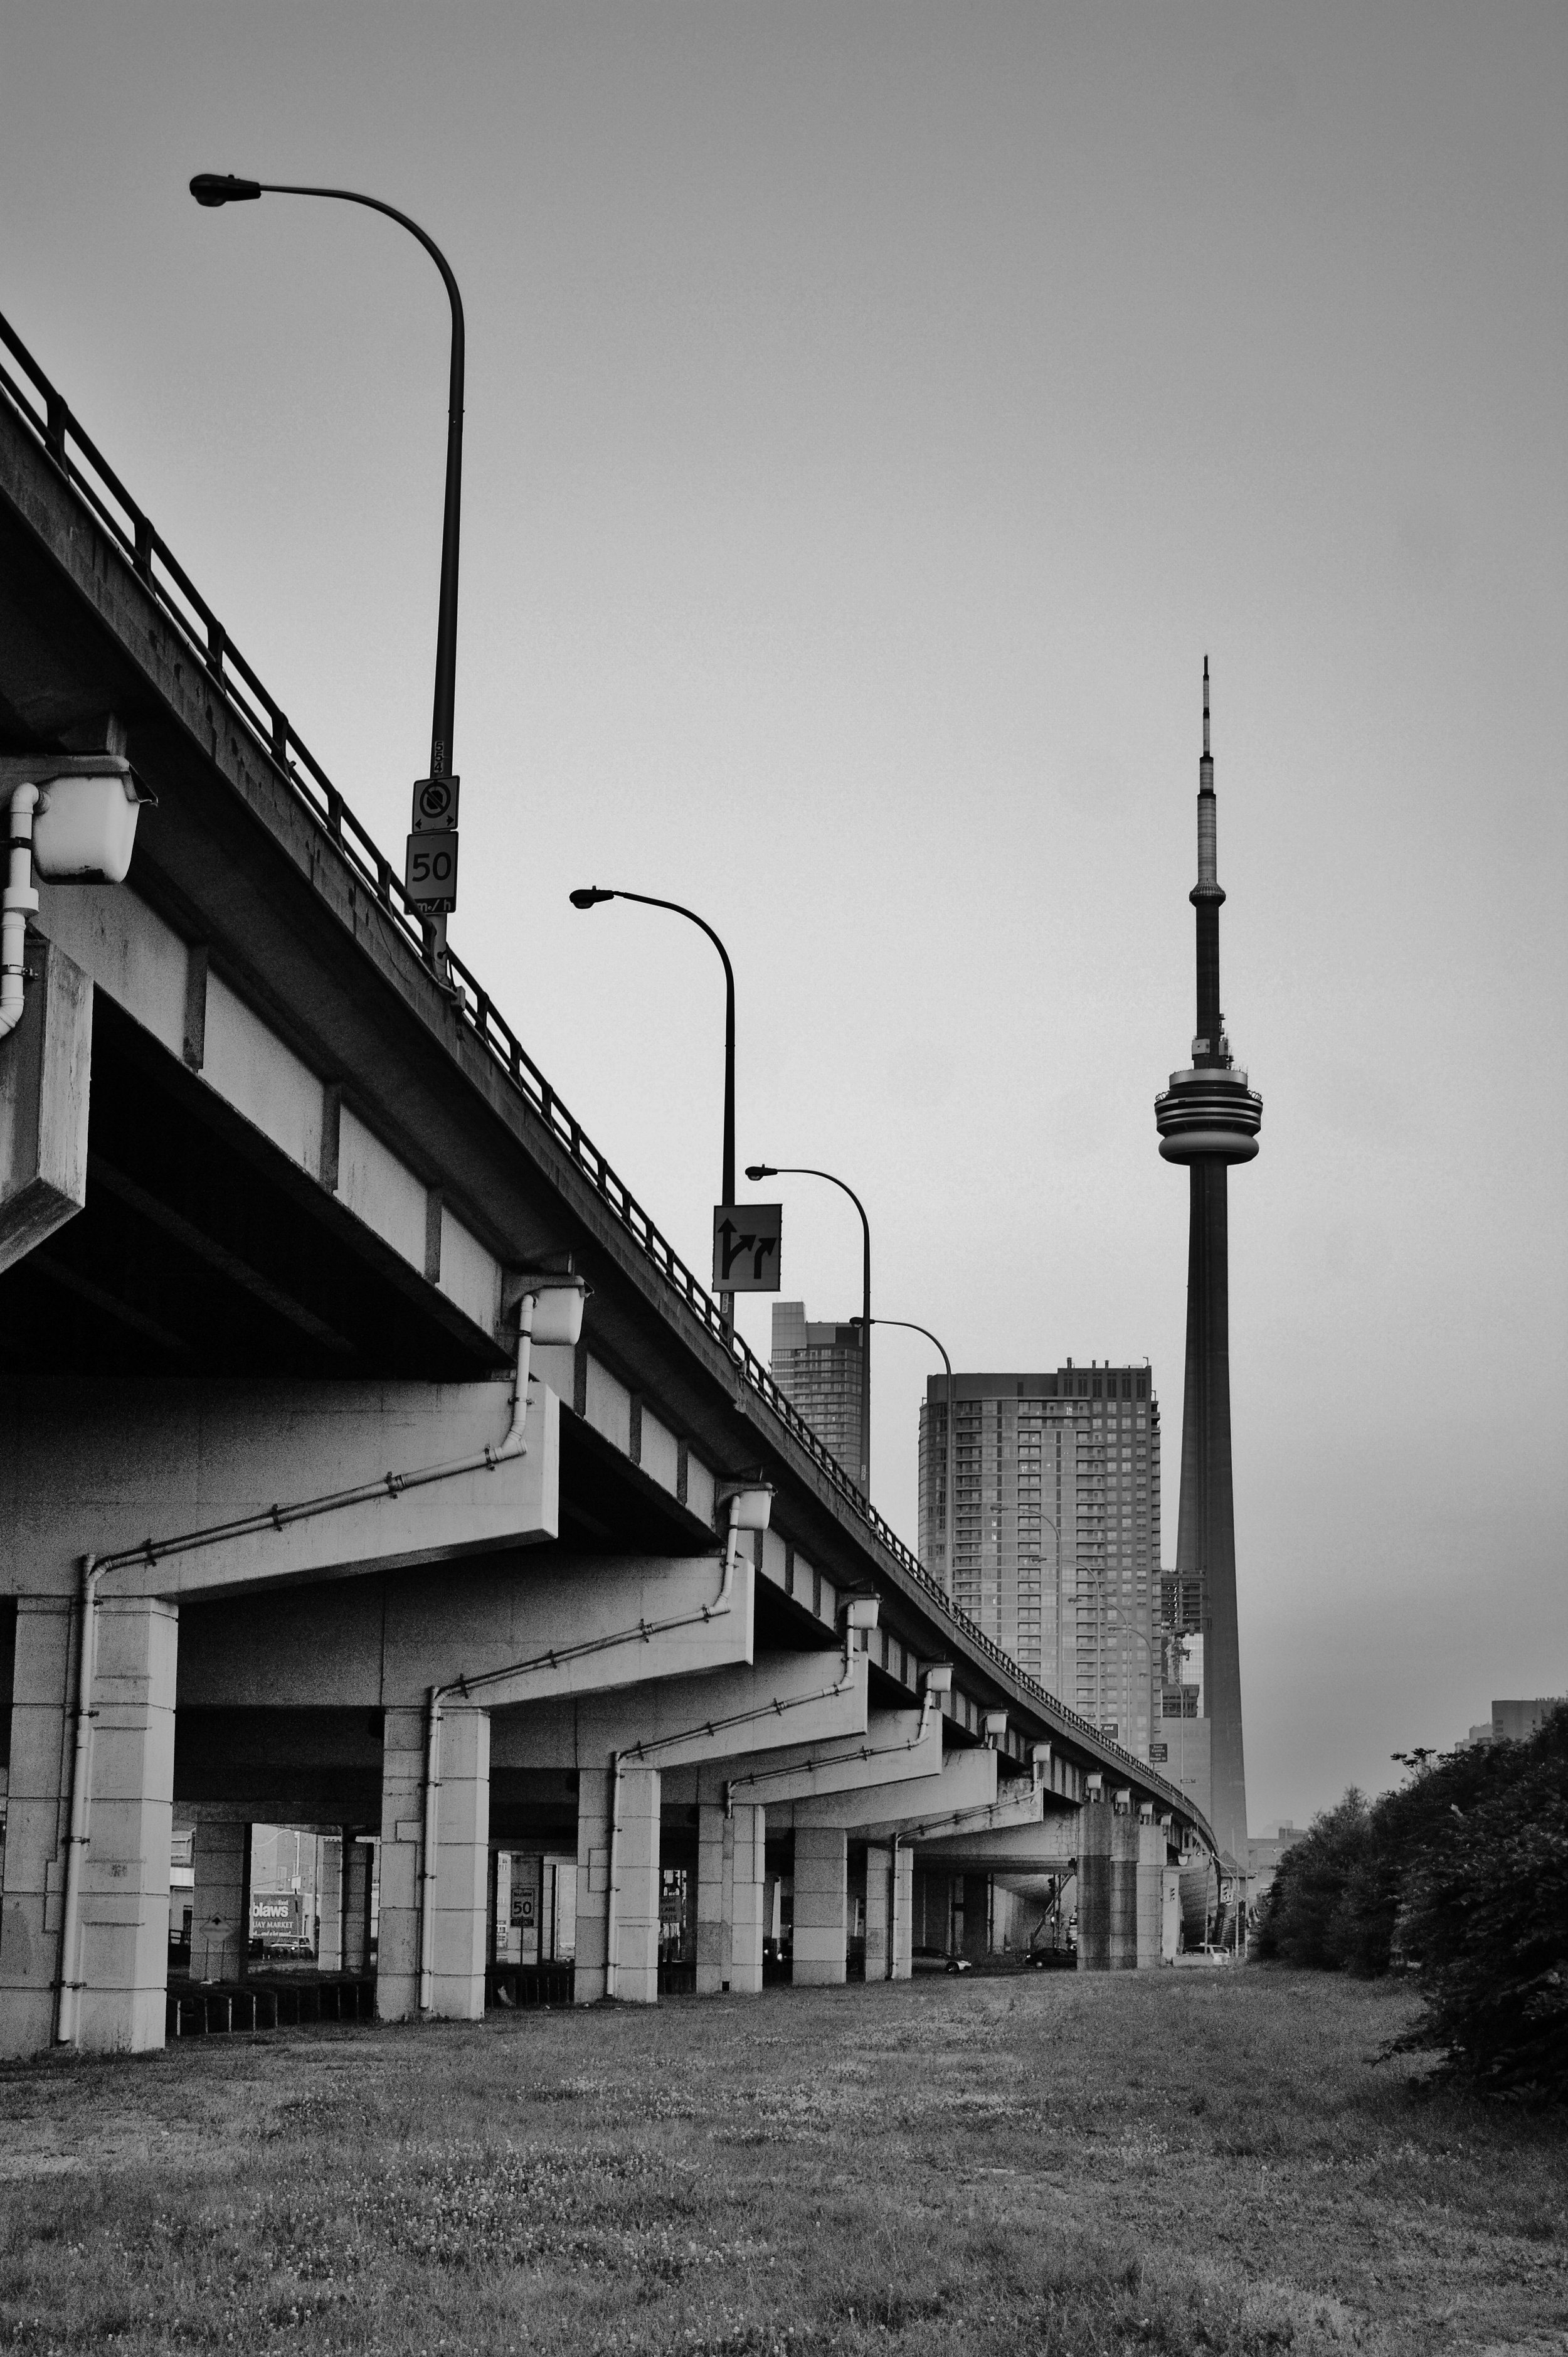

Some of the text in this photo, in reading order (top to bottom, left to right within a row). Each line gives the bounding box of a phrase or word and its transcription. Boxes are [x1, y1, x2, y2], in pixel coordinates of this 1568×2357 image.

[435, 742, 443, 772] 554
[412, 851, 451, 881] 50
[514, 1902, 531, 1914] 50
